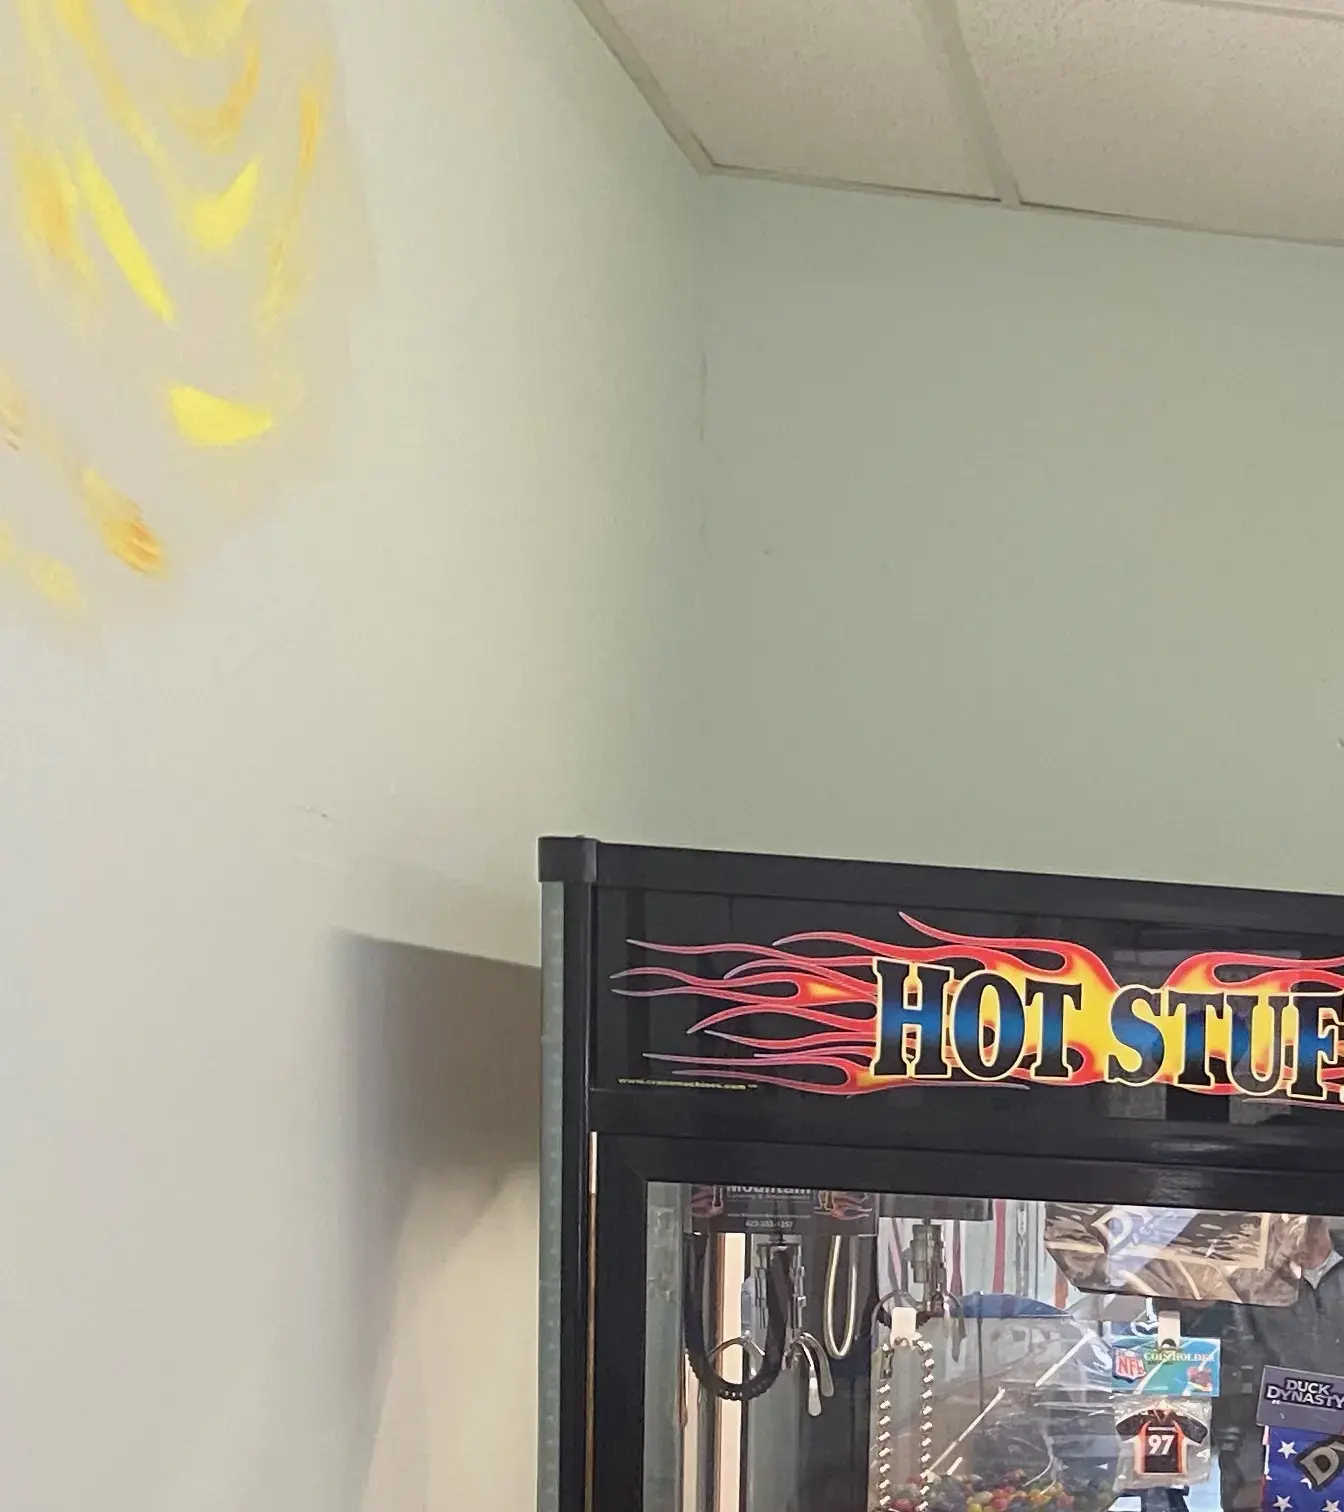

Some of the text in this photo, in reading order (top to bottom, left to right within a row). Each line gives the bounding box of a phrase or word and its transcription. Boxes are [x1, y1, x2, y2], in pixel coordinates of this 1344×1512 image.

[869, 957, 1087, 1081] HOT
[1116, 1356, 1145, 1377] NFL
[1285, 1378, 1331, 1397] DUCK
[1147, 1434, 1176, 1456] 97
